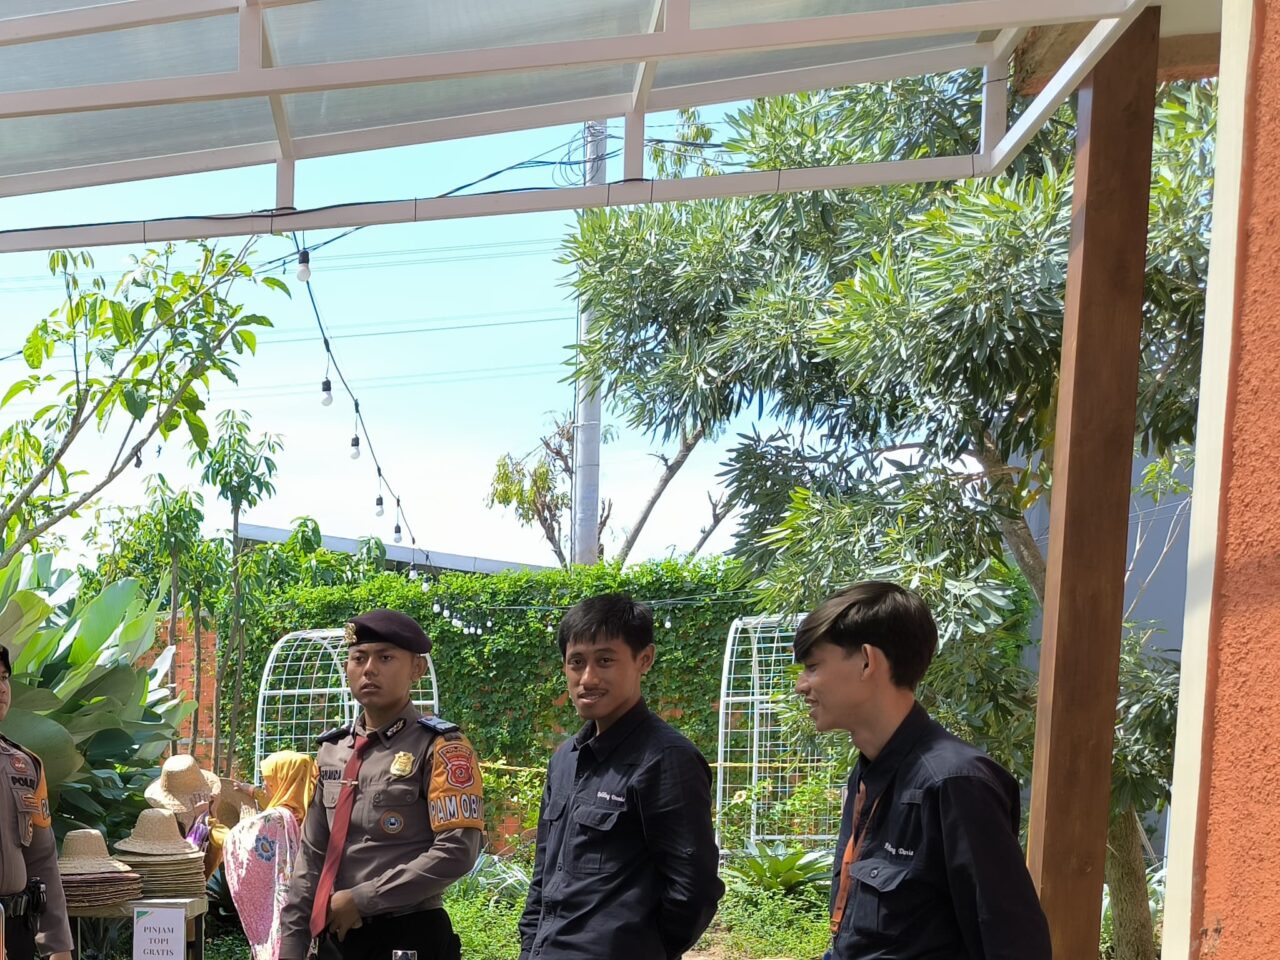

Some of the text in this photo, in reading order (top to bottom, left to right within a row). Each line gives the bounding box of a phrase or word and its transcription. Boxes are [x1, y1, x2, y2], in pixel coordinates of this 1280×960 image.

[430, 794, 459, 823] PAM
[143, 926, 174, 934] PINJAM
[149, 937, 169, 945] TOPI
[143, 948, 174, 956] GRATIS
